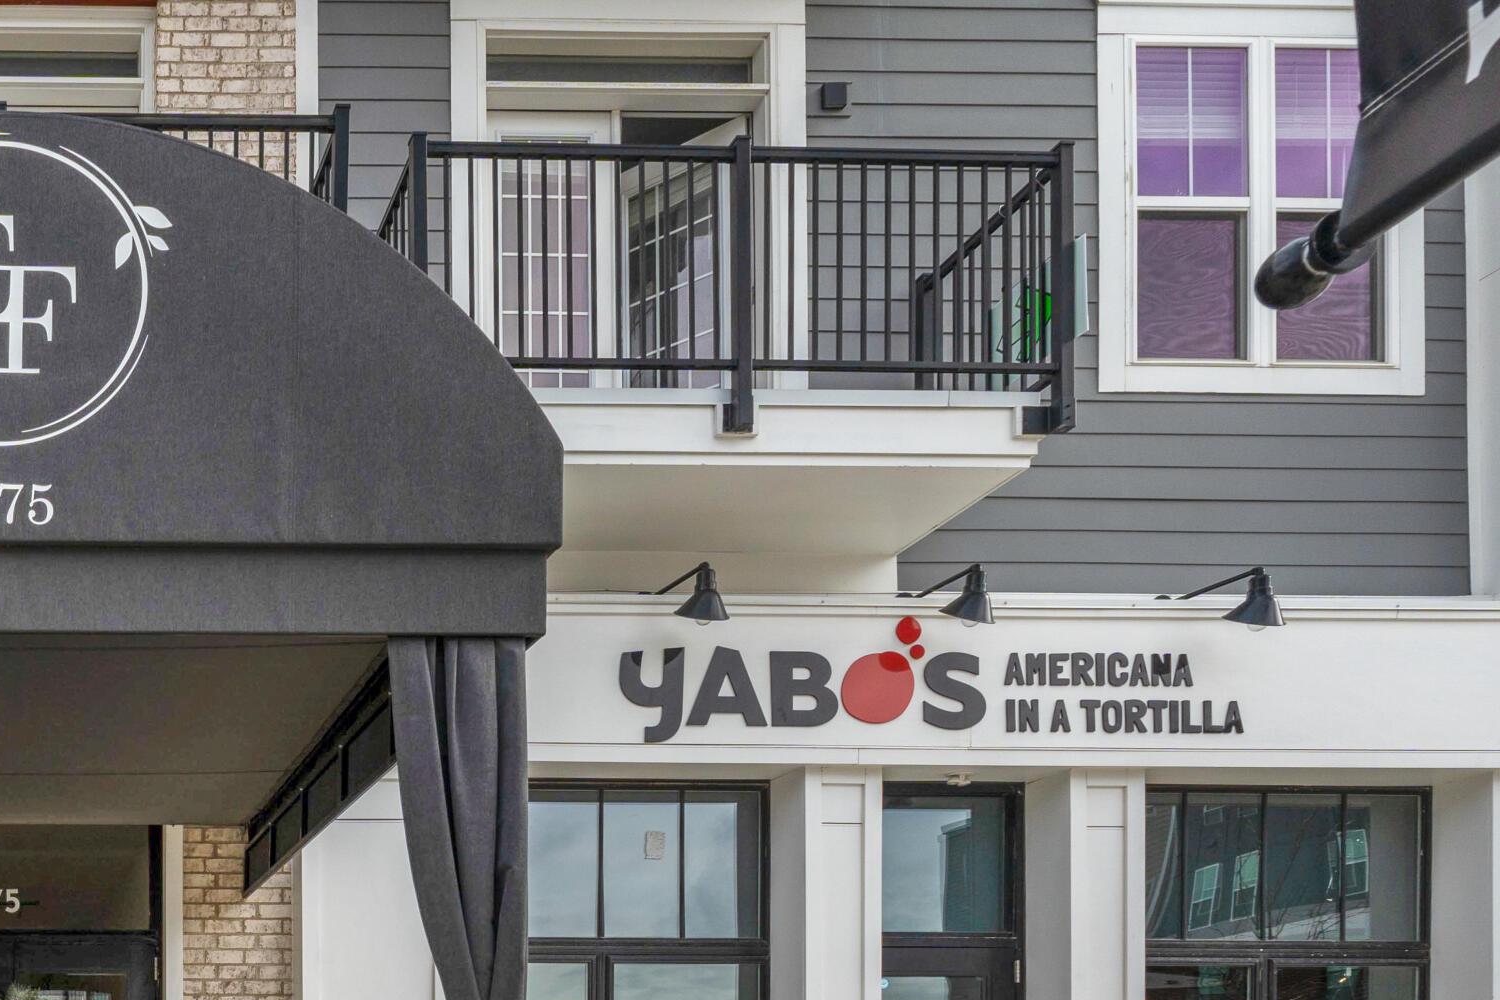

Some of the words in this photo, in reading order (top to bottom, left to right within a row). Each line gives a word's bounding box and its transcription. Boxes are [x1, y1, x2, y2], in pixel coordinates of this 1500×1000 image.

[1003, 652, 1194, 687] AMERICANA
[1005, 699, 1040, 733] IN
[1050, 699, 1071, 733] A
[1080, 699, 1244, 734] TORTILLA
